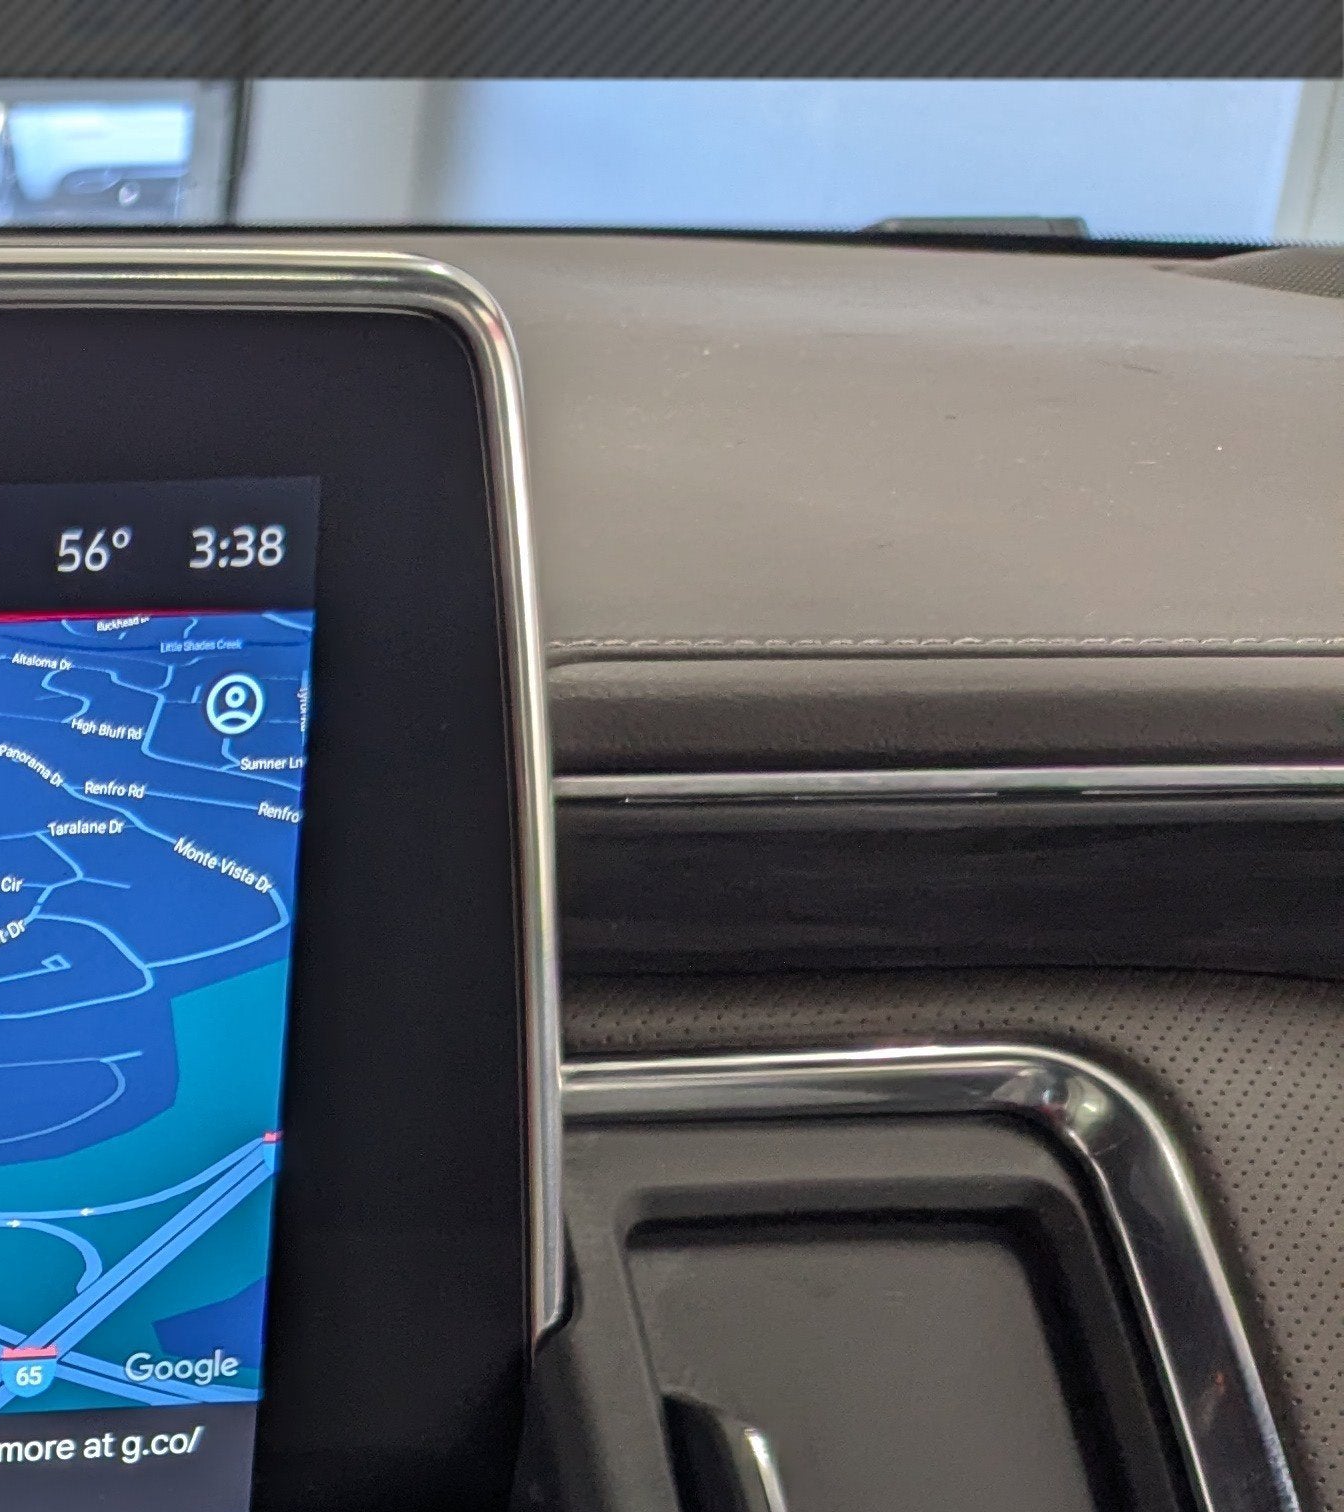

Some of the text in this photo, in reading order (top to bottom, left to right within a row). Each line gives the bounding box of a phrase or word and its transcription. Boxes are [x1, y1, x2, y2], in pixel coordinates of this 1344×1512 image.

[57, 527, 133, 572] 56°
[190, 526, 285, 569] 3:38
[59, 658, 72, 671] Dr
[70, 717, 143, 741] High Bluff Rd
[240, 757, 304, 772] Sumner Ln
[50, 772, 64, 788] Dr
[84, 780, 145, 799] Renfro Rd
[257, 801, 302, 823] Renfro
[47, 820, 125, 837] Taralane Dr
[172, 836, 273, 893] Monte Vista Dr
[0, 875, 24, 893] Cir
[5, 917, 26, 940] Dr
[15, 1365, 43, 1387] 65
[124, 1348, 239, 1385] Google
[83, 1432, 115, 1459] at
[121, 1425, 206, 1465] g.co/
